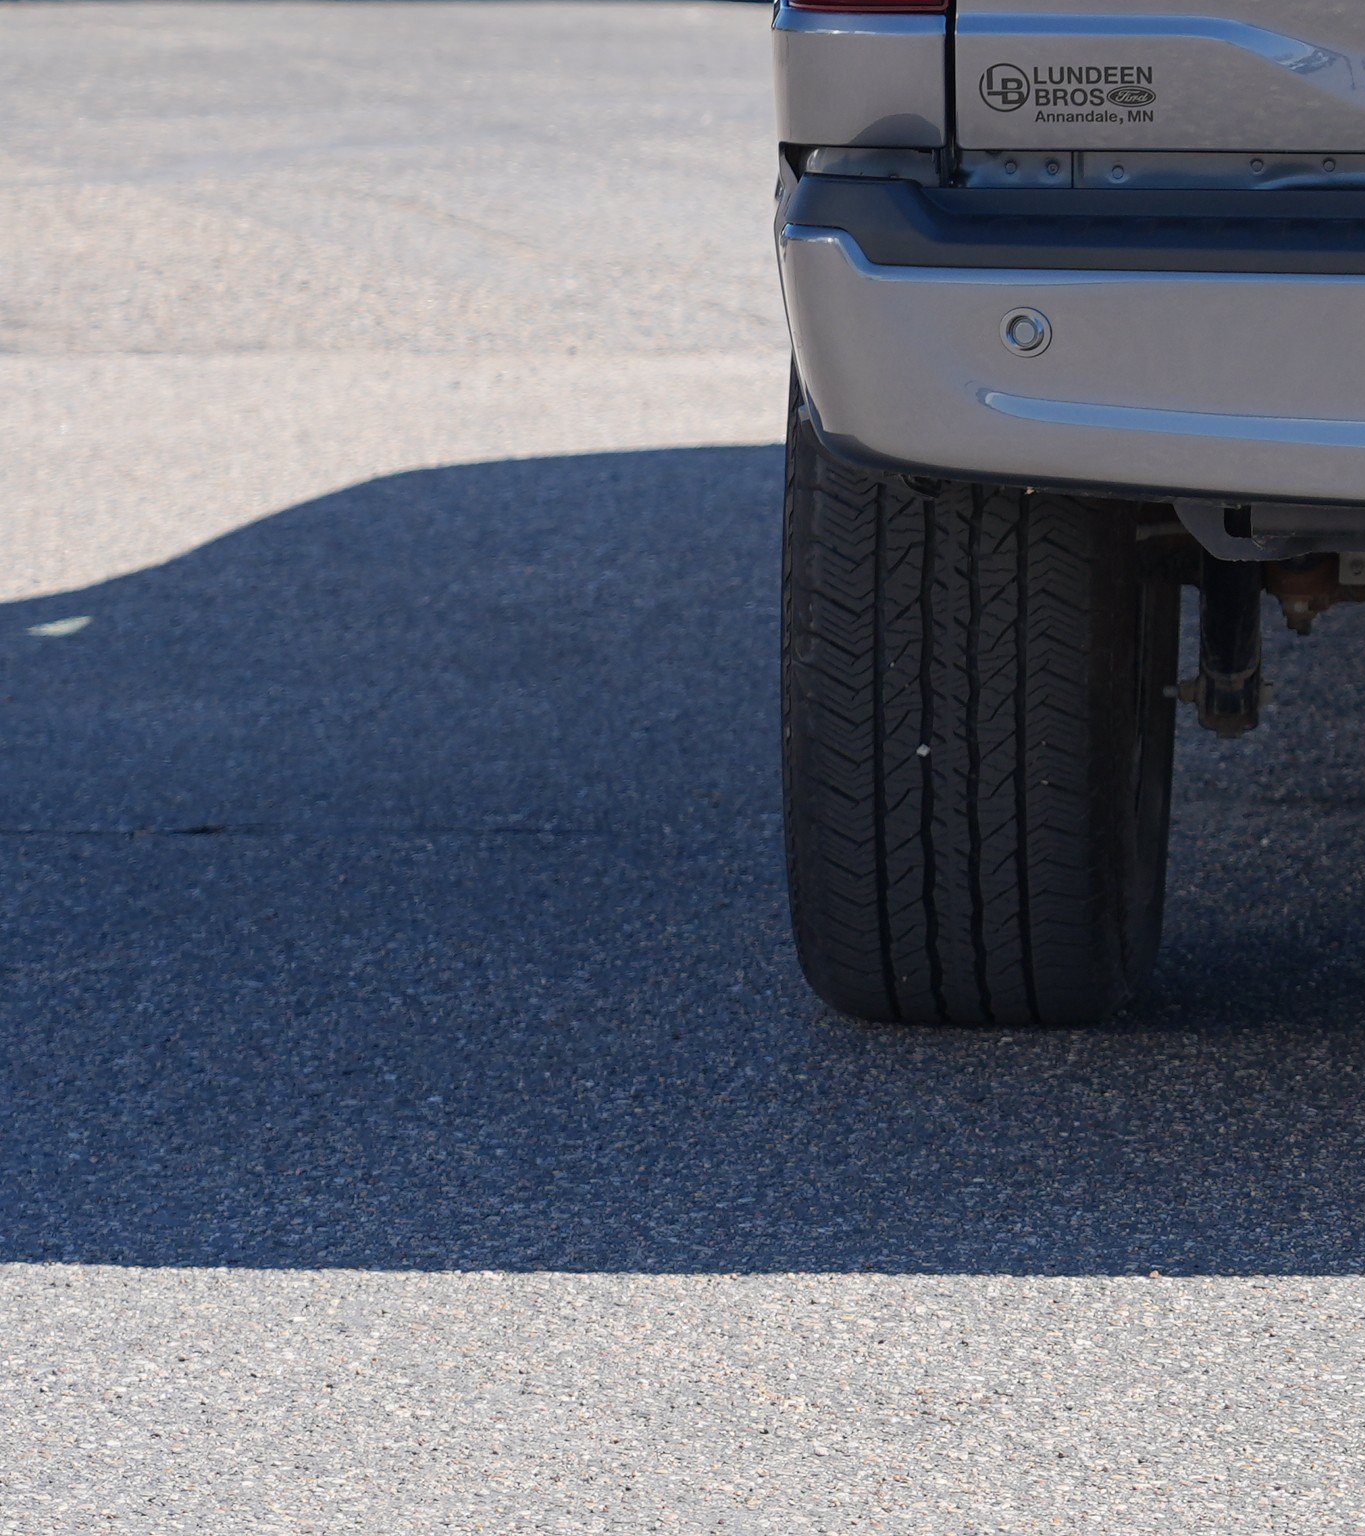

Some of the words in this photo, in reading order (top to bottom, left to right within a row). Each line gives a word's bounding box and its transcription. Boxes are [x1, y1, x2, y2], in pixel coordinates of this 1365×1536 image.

[1033, 66, 1153, 85] LUNDEEN
[1034, 88, 1105, 107] BROS
[1035, 110, 1124, 124] Annandale,
[1127, 110, 1154, 123] MN
